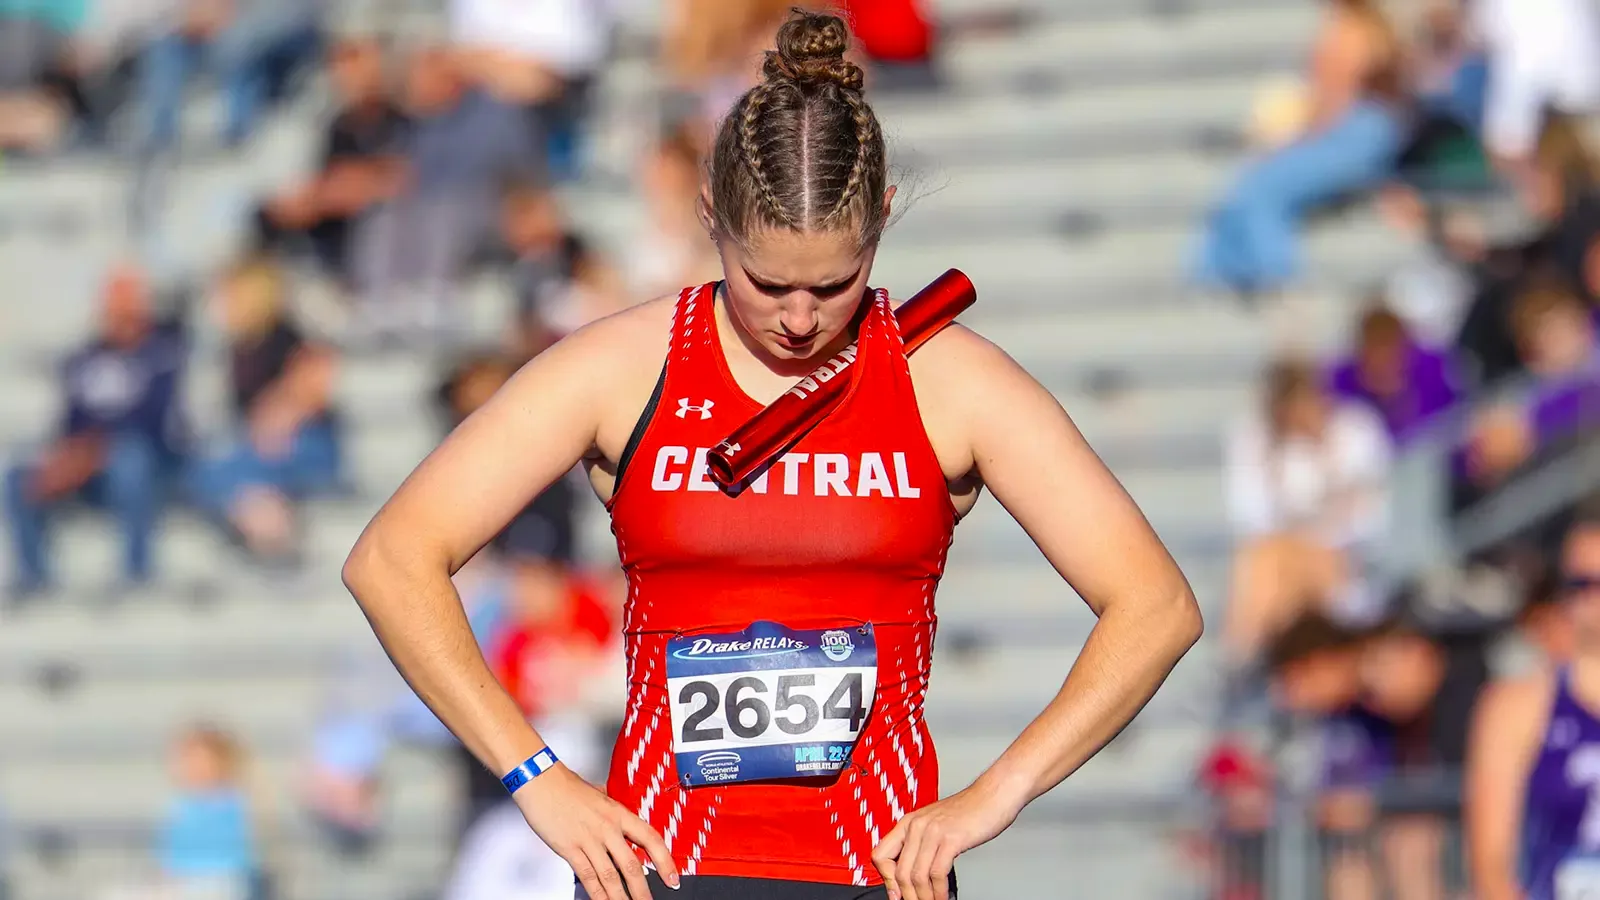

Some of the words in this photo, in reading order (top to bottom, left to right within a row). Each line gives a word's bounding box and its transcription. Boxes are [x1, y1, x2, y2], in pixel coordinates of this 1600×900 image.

[688, 638, 751, 655] Drake
[825, 636, 848, 646] 100
[678, 673, 866, 743] 2654
[795, 746, 827, 762] APRIL
[701, 765, 739, 775] Continental
[704, 774, 719, 782] Tour
